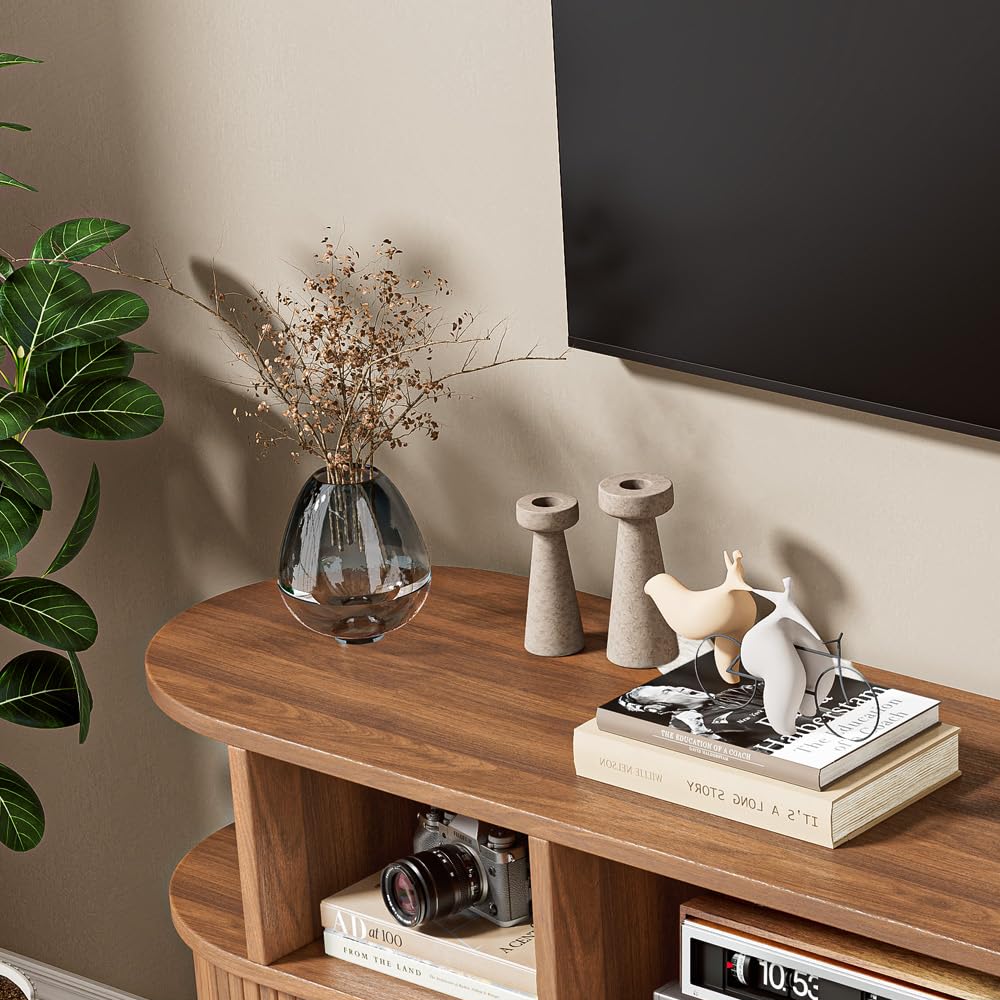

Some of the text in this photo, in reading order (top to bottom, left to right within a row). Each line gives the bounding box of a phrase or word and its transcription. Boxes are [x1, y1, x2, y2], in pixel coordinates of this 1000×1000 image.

[661, 730, 674, 739] THE
[675, 732, 712, 749] EDUCATION
[713, 744, 722, 752] OF
[728, 748, 751, 760] COACH
[333, 910, 403, 948] AD at 100
[343, 946, 422, 977] FROM THE LAND
